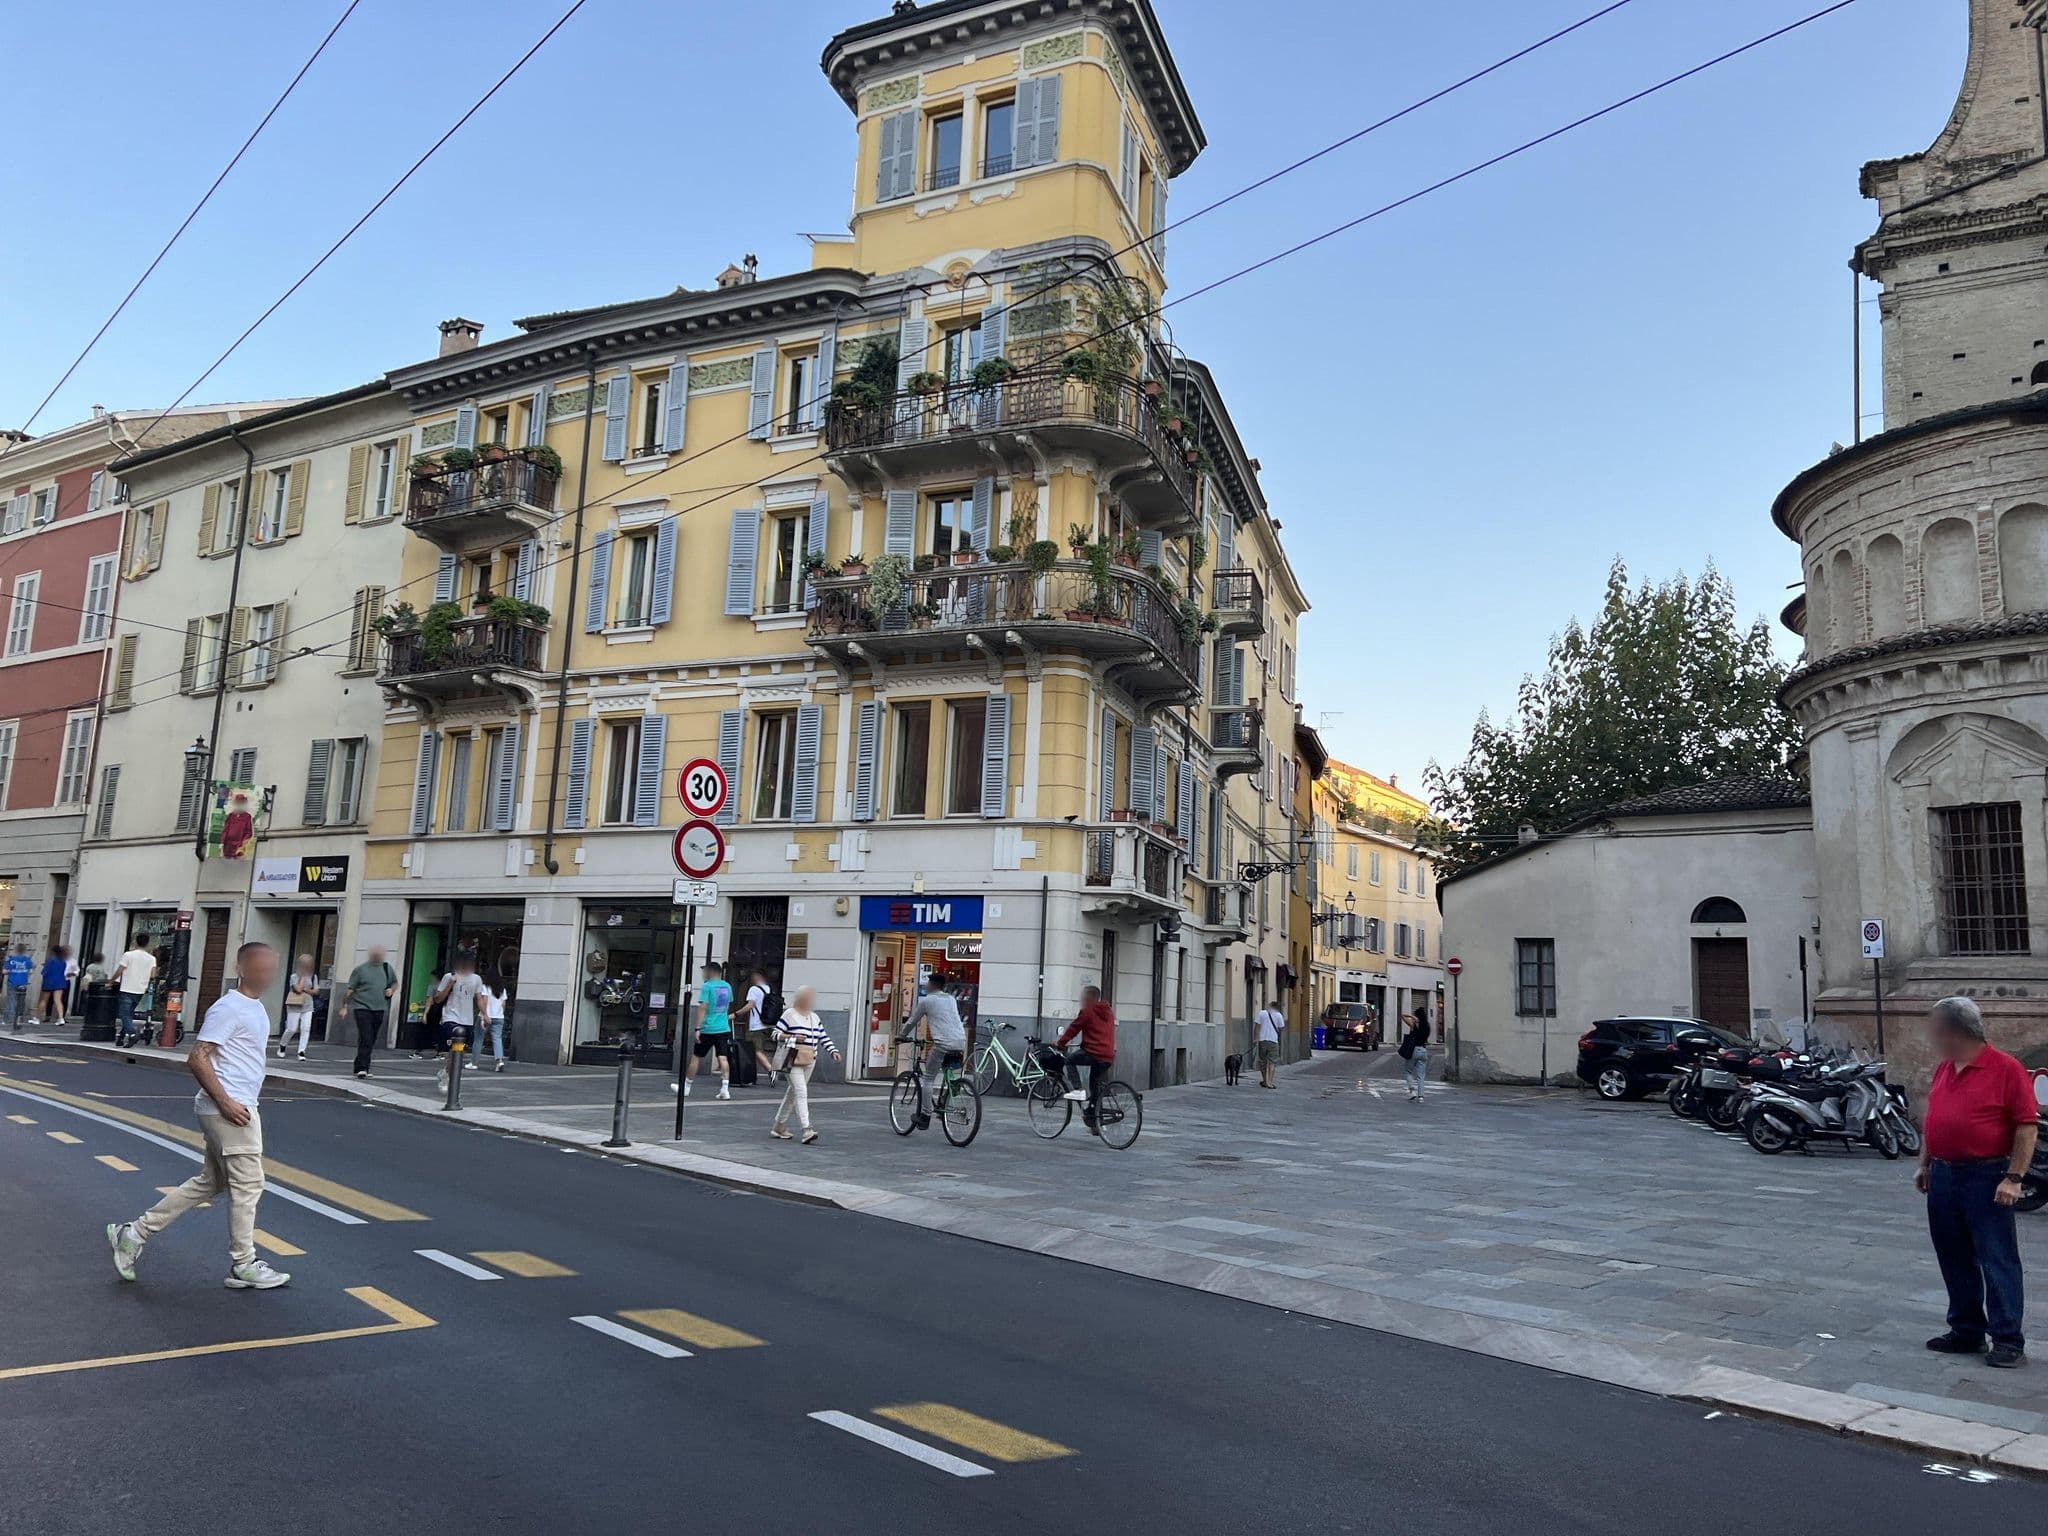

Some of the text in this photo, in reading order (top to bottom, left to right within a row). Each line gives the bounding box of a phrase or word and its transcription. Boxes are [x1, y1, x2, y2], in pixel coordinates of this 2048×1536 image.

[691, 773, 718, 802] 30
[321, 866, 344, 874] Western
[320, 873, 337, 881] Union
[913, 903, 951, 923] TIM
[952, 942, 967, 954] sky
